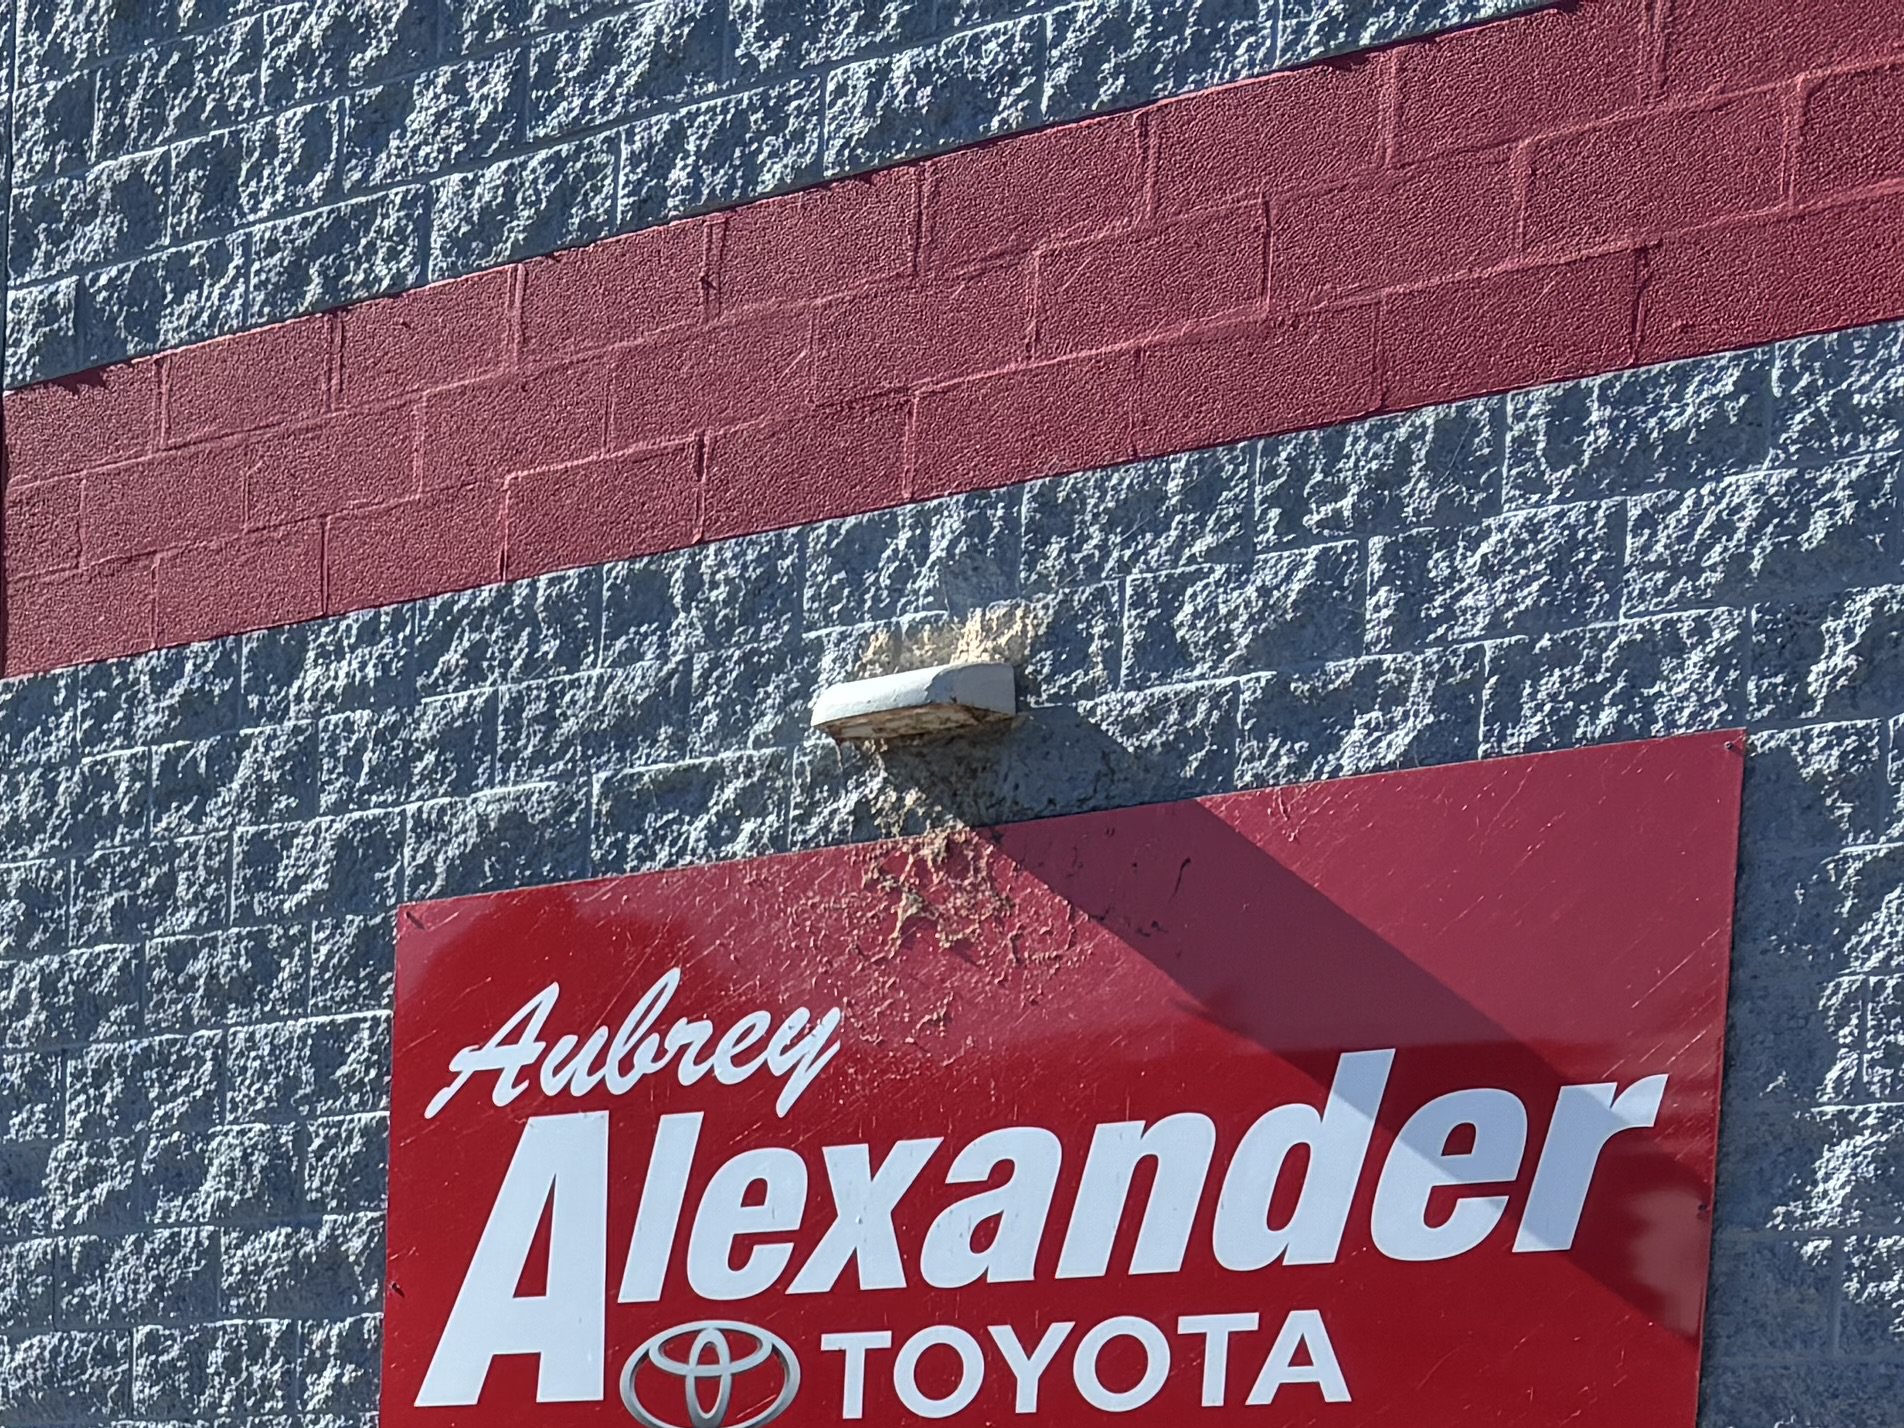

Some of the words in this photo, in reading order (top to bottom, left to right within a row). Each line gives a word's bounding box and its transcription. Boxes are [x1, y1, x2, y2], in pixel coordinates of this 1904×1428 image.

[423, 966, 841, 1119] Aubrey
[414, 1048, 1669, 1408] Alexander
[821, 1310, 1352, 1420] TOYOTA
